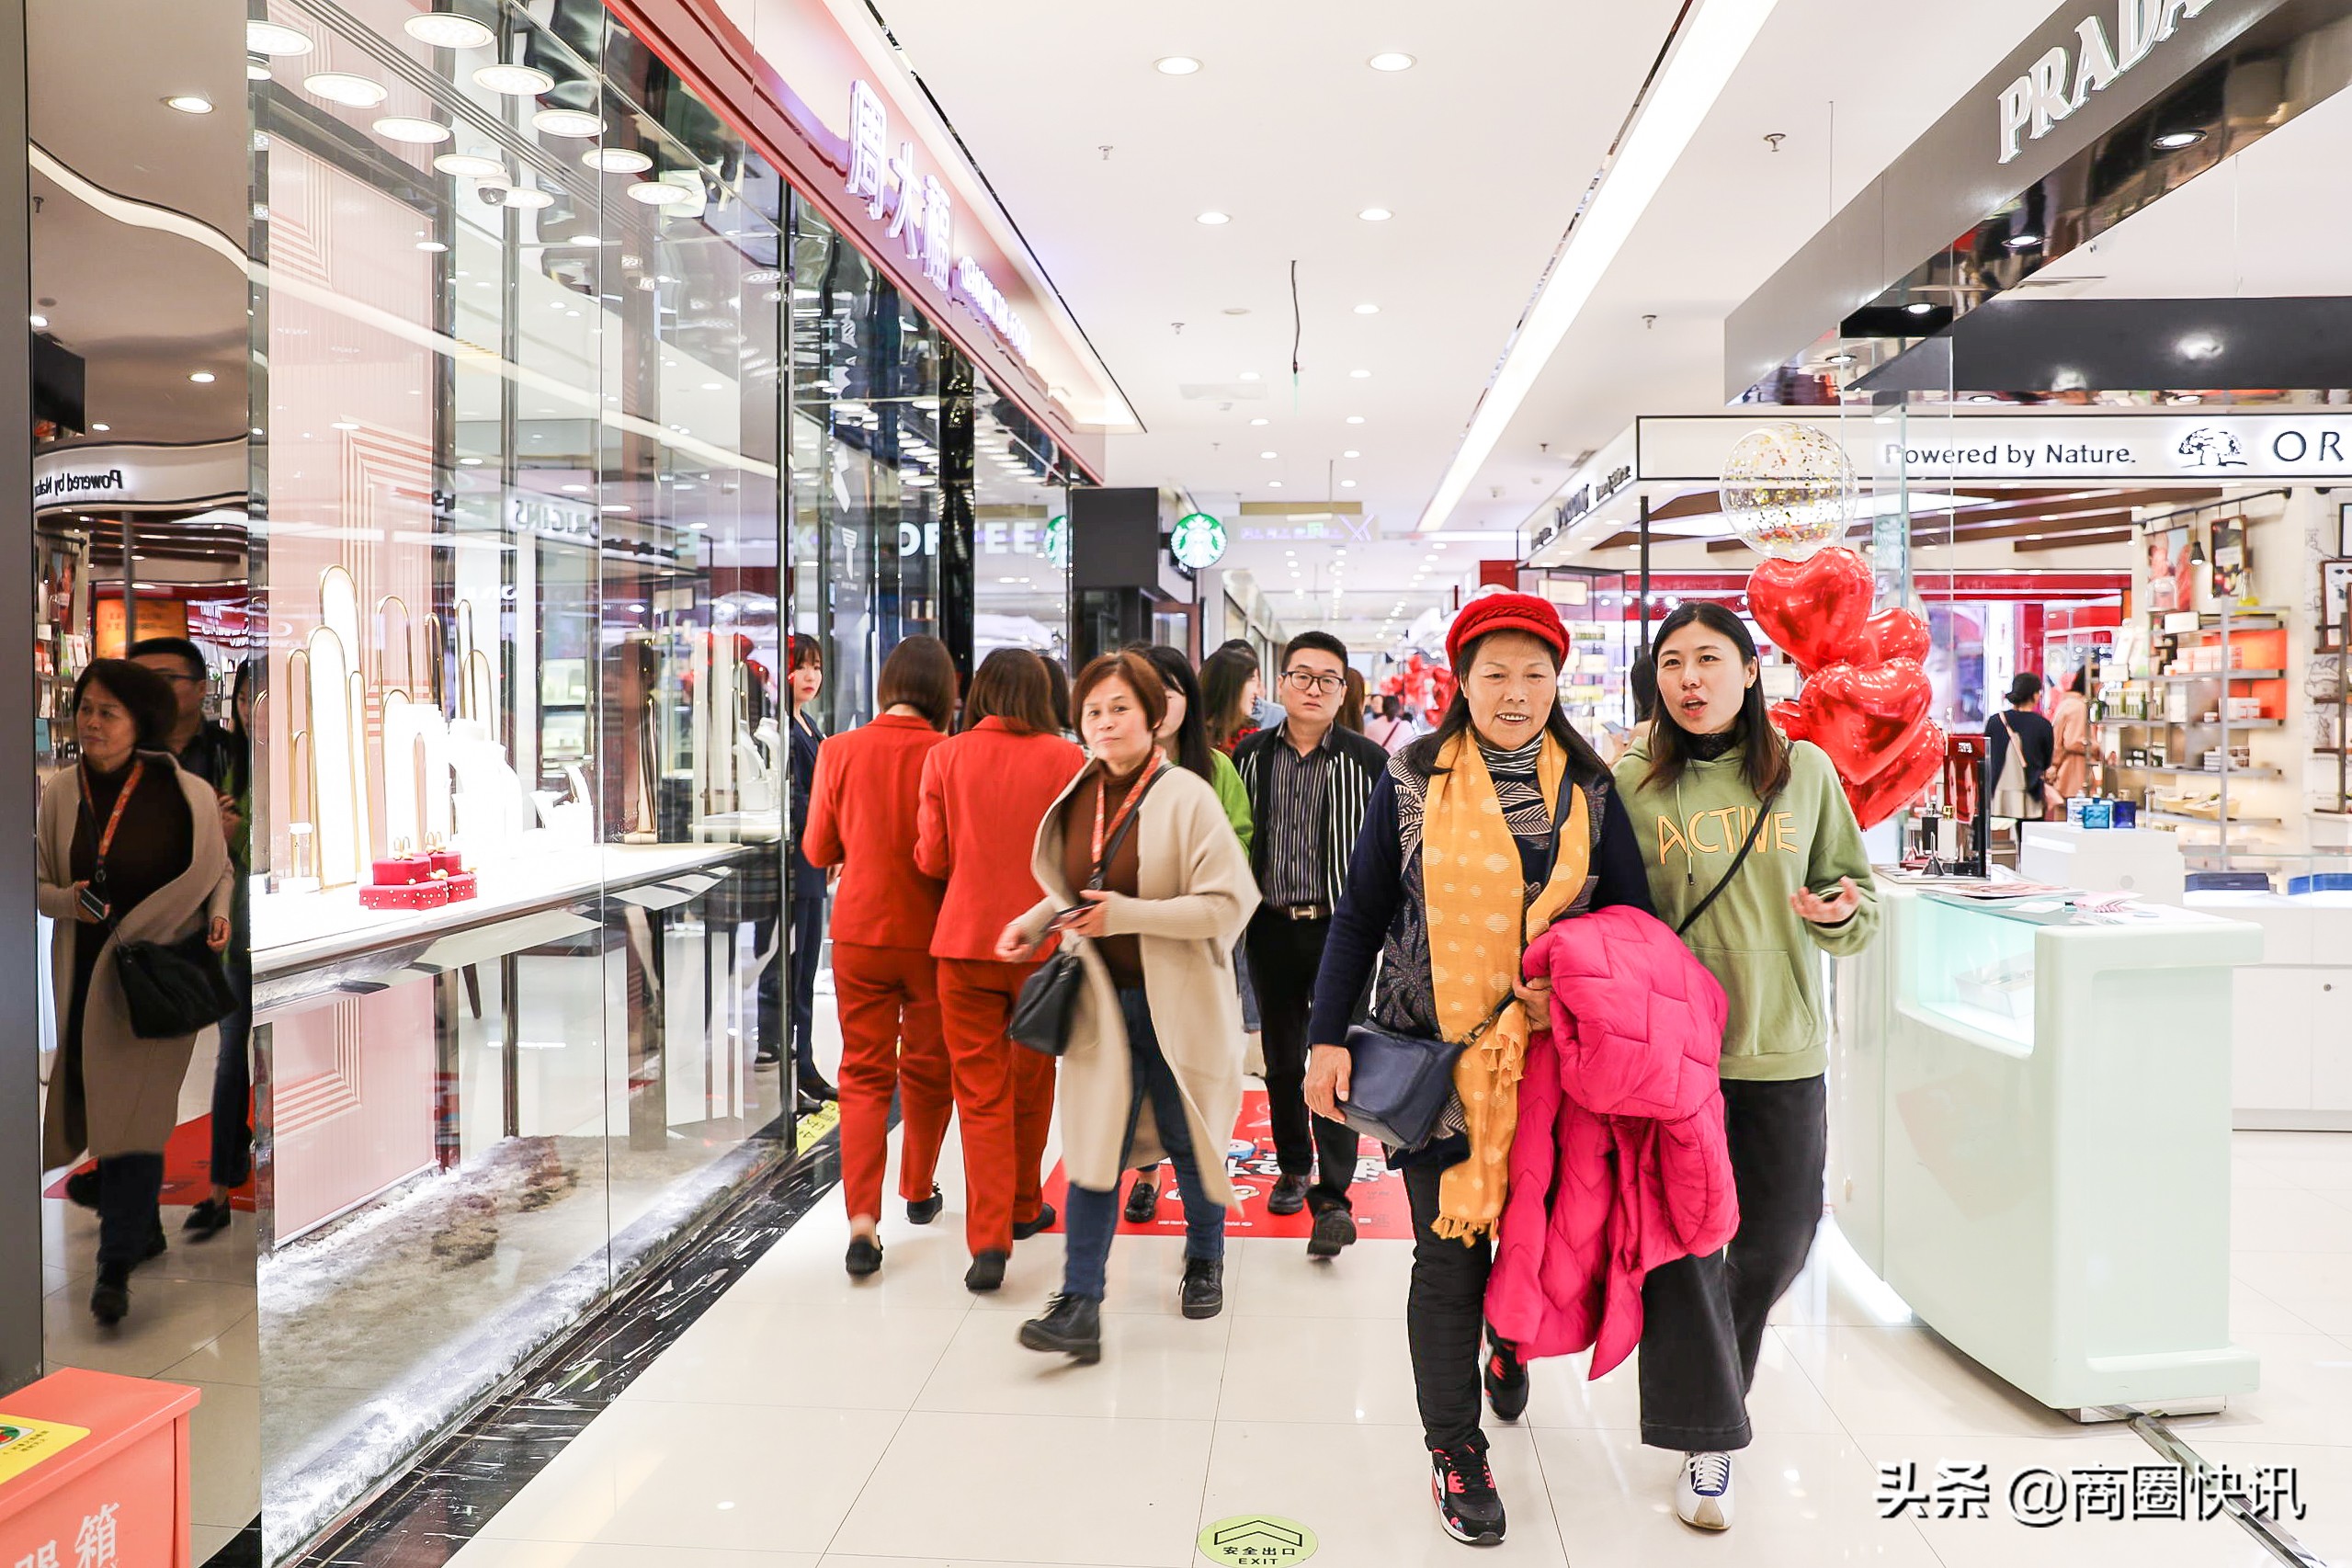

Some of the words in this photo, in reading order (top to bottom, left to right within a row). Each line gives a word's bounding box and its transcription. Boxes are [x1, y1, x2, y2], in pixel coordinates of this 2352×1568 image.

[846, 79, 951, 292] 周大福
[1886, 444, 1997, 464] Powered
[2007, 445, 2036, 468] by
[2047, 445, 2136, 463] Nature.
[2273, 431, 2345, 462] OR
[1657, 805, 1799, 866] ACTIVE
[1223, 1546, 1295, 1555] 安全出口
